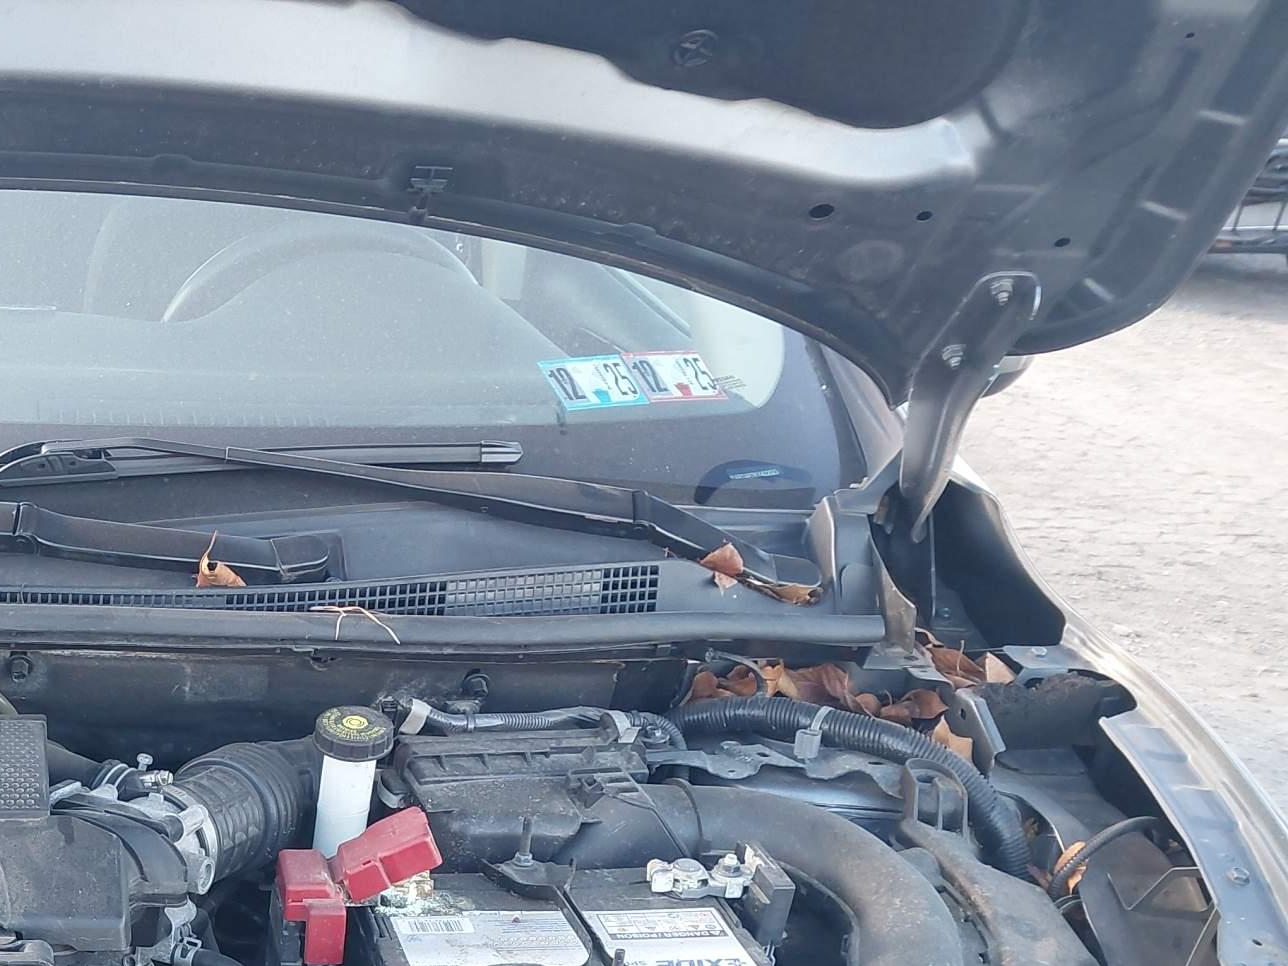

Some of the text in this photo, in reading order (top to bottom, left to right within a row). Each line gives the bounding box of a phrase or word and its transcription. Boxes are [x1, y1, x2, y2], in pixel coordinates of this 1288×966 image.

[548, 362, 638, 401] 12 25
[632, 358, 670, 393] 12
[682, 356, 718, 391] 25
